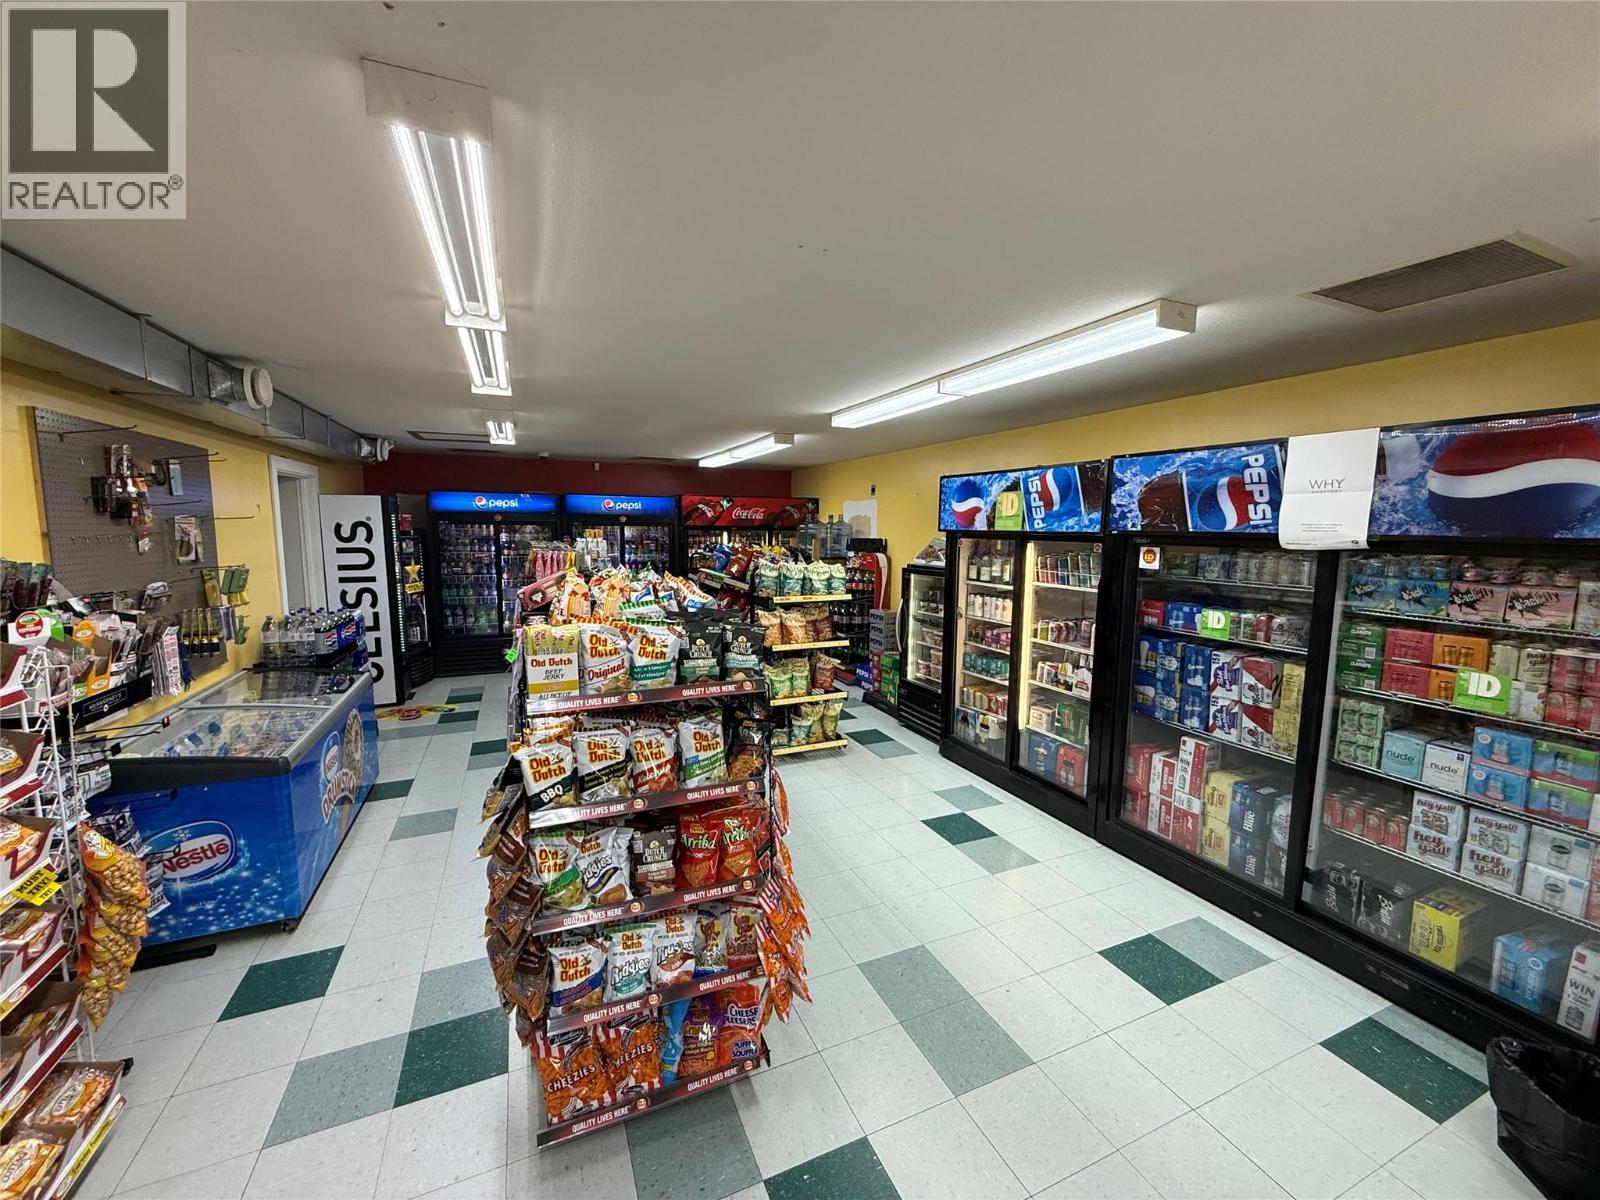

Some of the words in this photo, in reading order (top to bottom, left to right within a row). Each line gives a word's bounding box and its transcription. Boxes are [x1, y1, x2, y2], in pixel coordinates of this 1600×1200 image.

[1240, 452, 1273, 526] PEPSI
[1309, 478, 1346, 489] WHY
[488, 498, 519, 509] pepsi
[615, 500, 642, 511] pepsi
[1001, 493, 1019, 516] ID
[1028, 476, 1048, 529] PEPSI
[870, 612, 884, 621] PEPSI
[1208, 610, 1225, 629] ID
[870, 625, 884, 634] PEPSI
[589, 634, 608, 647] Old
[640, 635, 656, 648] Old
[590, 645, 620, 658] Dutch
[638, 647, 667, 660] Dutch
[530, 658, 546, 668] Old
[549, 657, 573, 667] Dutch
[588, 660, 626, 681] Original
[682, 688, 706, 697] QUALITY
[706, 686, 721, 695] LIVES
[722, 684, 737, 693] HERE
[1468, 671, 1502, 698] ID
[559, 698, 583, 709] QUALITY
[585, 697, 602, 707] LIVES
[603, 695, 620, 704] HERE
[693, 731, 710, 742] Old
[588, 740, 607, 751] Old
[695, 741, 720, 753] Dutch
[590, 750, 622, 763] Dutch
[1386, 750, 1415, 763] nude
[530, 757, 550, 770] Old
[1430, 762, 1458, 775] nude
[532, 766, 566, 783] Dutch
[540, 785, 564, 802] BBQ
[687, 791, 709, 800] QUALITY
[710, 788, 726, 797] LIVES
[726, 785, 741, 795] HERE
[592, 804, 609, 815] LIVES
[609, 802, 627, 812] HERE
[680, 833, 716, 849] Arriba
[539, 849, 558, 860] Old
[644, 847, 665, 856] DUTCH
[643, 854, 668, 863] CRUNCH
[16, 869, 45, 894] MUST
[684, 893, 707, 901] QUALITY
[707, 889, 722, 898] LIVES
[722, 885, 738, 894] HERE
[563, 914, 588, 926] QUALITY
[589, 911, 607, 921] LIVES
[606, 907, 624, 916] HERE
[665, 917, 677, 926] Old
[666, 924, 685, 933] Dutch
[622, 933, 634, 942] Old
[622, 940, 643, 951] Dutch
[560, 956, 579, 970] Old
[560, 967, 591, 982] Dutch
[611, 957, 650, 987] Ridgies
[700, 980, 721, 990] QUALITY
[721, 975, 736, 986] LIVES
[736, 970, 751, 981] HERE
[1569, 978, 1596, 998] WIN
[583, 1009, 608, 1022] QUALITY
[609, 1004, 625, 1015] LIVES
[625, 1000, 641, 1011] HERE
[548, 1065, 596, 1092] CHEEZIES
[688, 1080, 709, 1091] QUALITY
[709, 1075, 725, 1085] LIVES
[724, 1068, 739, 1080] HERE
[572, 1119, 596, 1133] QUALITY
[596, 1113, 612, 1124] LIVES
[613, 1106, 630, 1118] HERE
